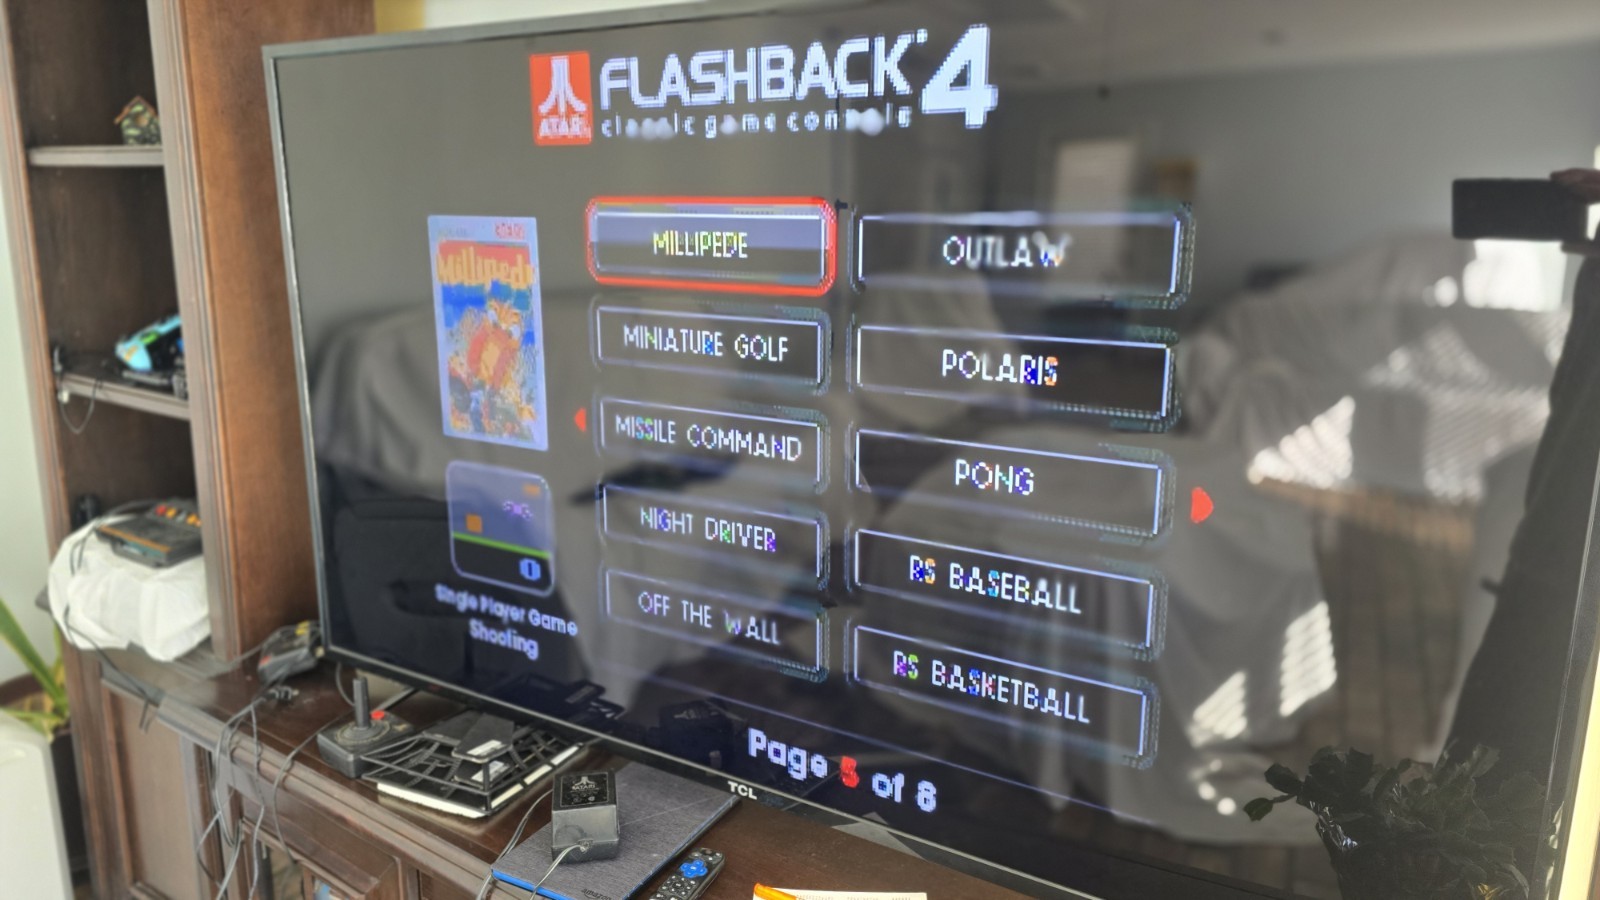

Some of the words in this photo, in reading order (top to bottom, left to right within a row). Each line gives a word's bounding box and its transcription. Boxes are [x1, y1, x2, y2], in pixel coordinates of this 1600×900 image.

[599, 36, 912, 110] FLASHBACK
[919, 23, 999, 129] 4
[653, 230, 749, 259] MILLIPEDE
[943, 230, 1073, 268] OUTLAW
[623, 324, 724, 357] MINIATURE
[734, 333, 789, 362] GOLF
[941, 348, 1059, 387] POLARIS
[615, 414, 677, 444] MISSILE
[686, 423, 803, 462] COMMAND
[955, 458, 1035, 496] PONG
[640, 507, 694, 535] NIGHT
[704, 517, 777, 553] DRIVER
[909, 554, 936, 585] RS
[949, 562, 1082, 614] BASEBALL
[434, 582, 478, 613] Single
[528, 608, 579, 637] Game
[638, 591, 671, 617] OFF
[681, 599, 714, 629] THE
[722, 607, 782, 646] WALL
[893, 650, 919, 680] RS
[931, 659, 1091, 725] BASKETBALL
[727, 780, 758, 801] TCL
[748, 727, 829, 781] Page
[871, 772, 906, 803] of
[916, 779, 938, 814] 8
